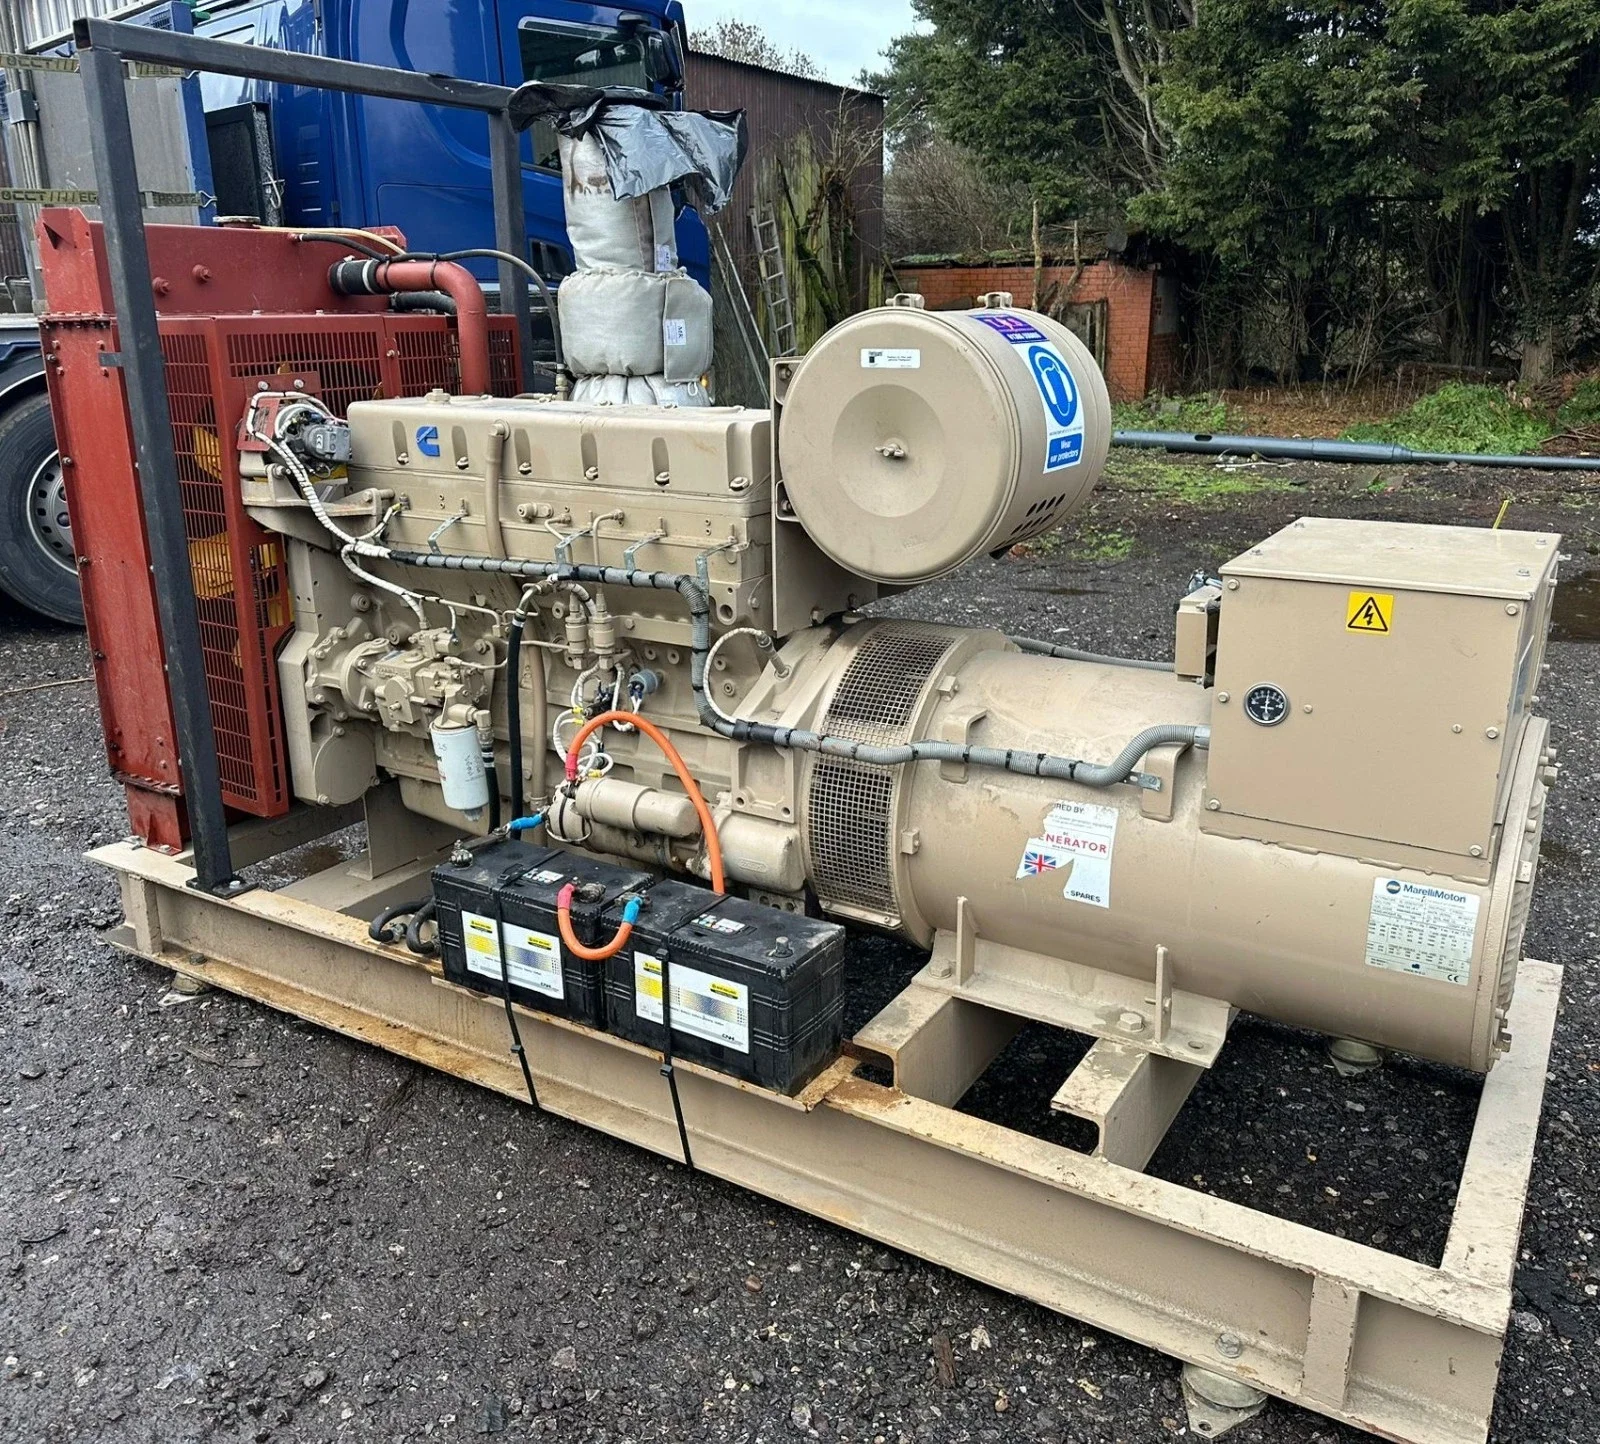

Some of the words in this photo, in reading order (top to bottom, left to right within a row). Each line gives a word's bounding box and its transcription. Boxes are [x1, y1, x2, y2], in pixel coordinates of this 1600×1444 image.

[1061, 439, 1072, 450] Wear
[1053, 802, 1072, 812] RED
[1070, 890, 1101, 903] SPARES
